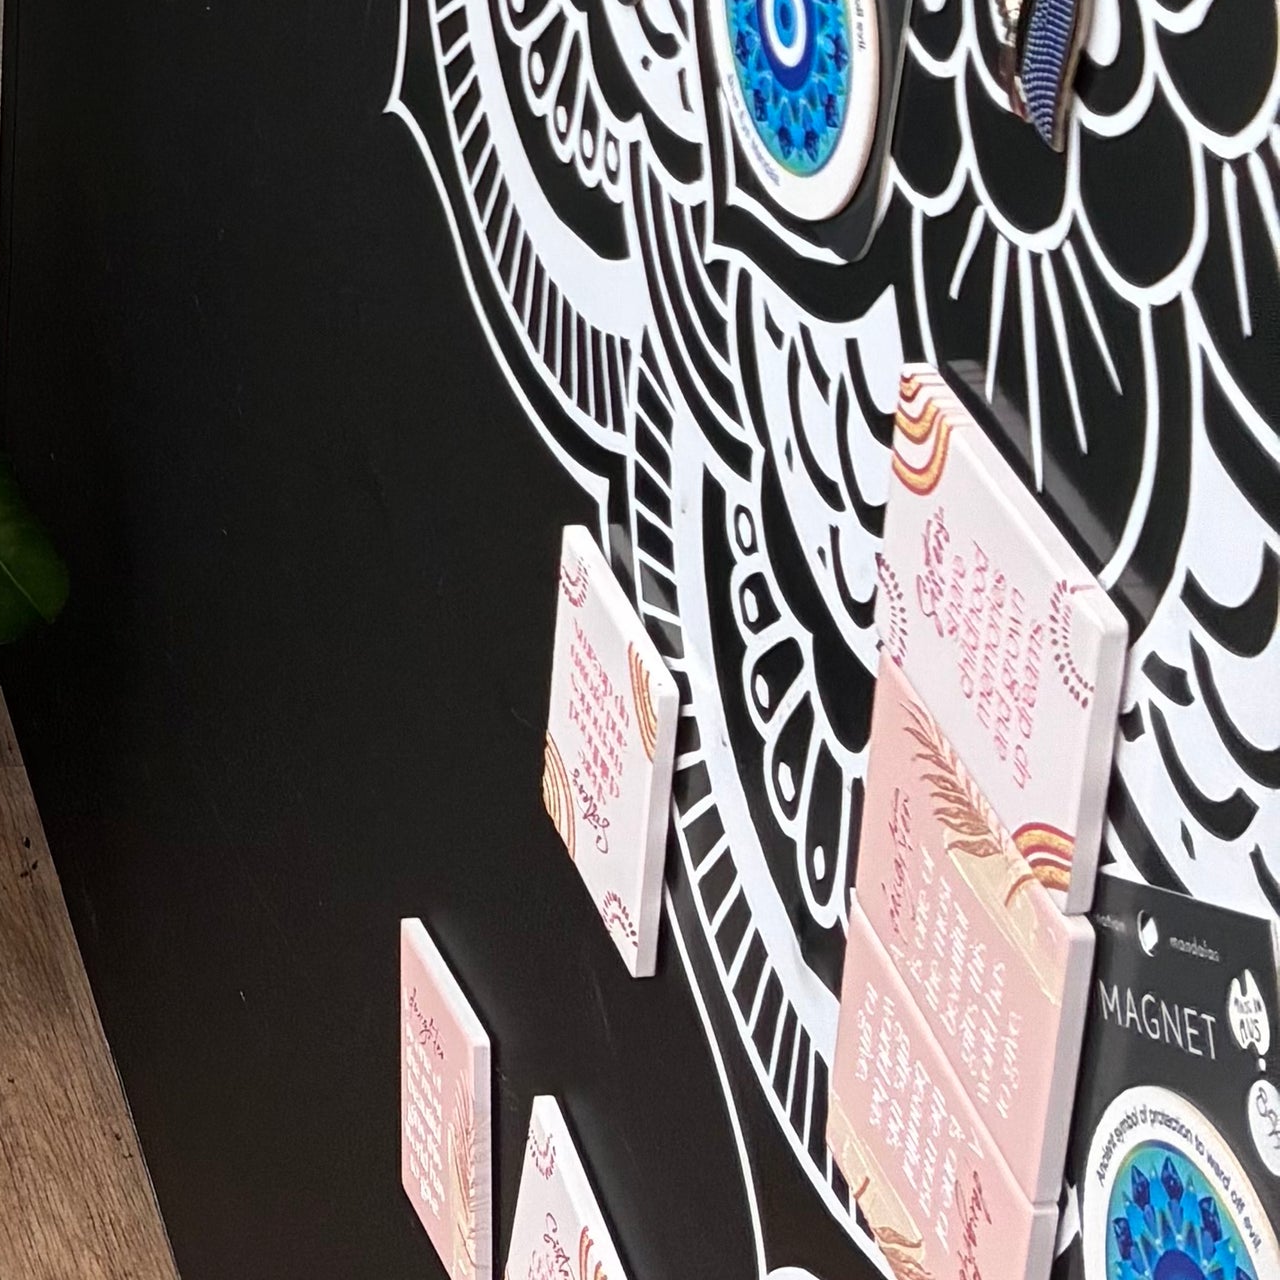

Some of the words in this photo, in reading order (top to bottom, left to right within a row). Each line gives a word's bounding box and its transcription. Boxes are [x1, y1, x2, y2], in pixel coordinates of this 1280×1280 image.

[945, 555, 966, 641] share
[958, 541, 989, 699] childhood
[977, 570, 1006, 728] memories
[994, 690, 1011, 761] and
[1003, 588, 1024, 702] grown
[1013, 744, 1032, 789] up
[1098, 979, 1216, 1060] MAGNET
[1096, 1132, 1115, 1188] Ancient
[1113, 1107, 1139, 1144] symbol
[1140, 1104, 1148, 1124] of
[1149, 1108, 1193, 1146] protection
[1194, 1134, 1205, 1156] to
[1206, 1151, 1232, 1191] ward
[1230, 1190, 1246, 1215] off
